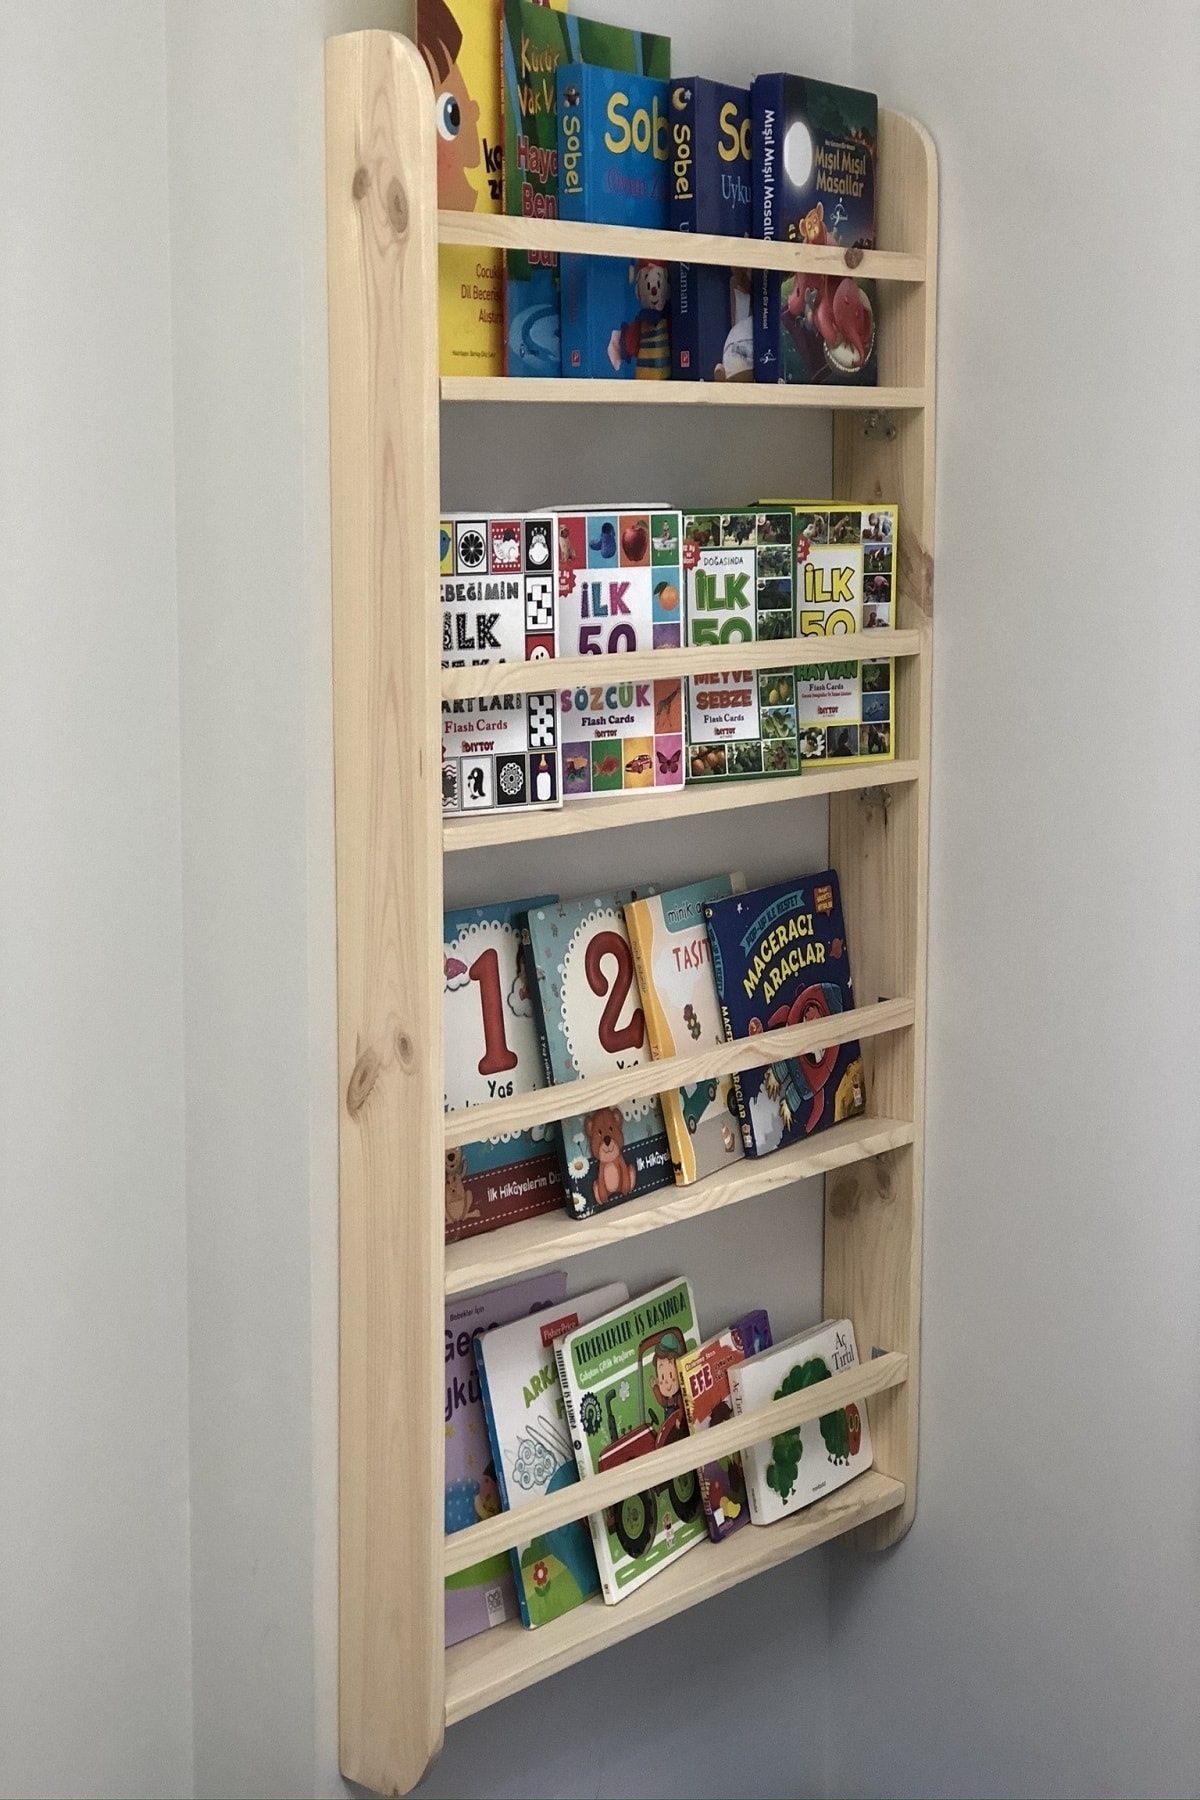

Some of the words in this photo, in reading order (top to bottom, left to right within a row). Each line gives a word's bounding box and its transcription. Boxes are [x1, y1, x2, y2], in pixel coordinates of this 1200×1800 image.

[517, 83, 541, 117] Vak
[563, 115, 583, 194] Sobe!
[673, 123, 693, 200] Sobe!
[816, 169, 865, 198] Masallar
[703, 556, 744, 566] DOĞASINDA
[580, 581, 632, 619] İLK
[694, 568, 751, 611] İLK
[804, 563, 855, 604] İLK
[561, 681, 651, 713] SÖZCÜK
[696, 688, 752, 710] SEBZE
[444, 720, 474, 733] Flash
[476, 718, 508, 731] Cards
[581, 716, 606, 727] Flash
[608, 714, 635, 724] Cards
[703, 714, 723, 723] Flash
[724, 713, 745, 722] Cards
[742, 913, 815, 1000] MACERACI
[584, 930, 646, 1054] 2
[468, 948, 519, 1076] 1
[500, 1175, 547, 1200] Hikâyelerim
[575, 1320, 634, 1366] TEKERLEKLER
[645, 1292, 687, 1329] BAŞINDA
